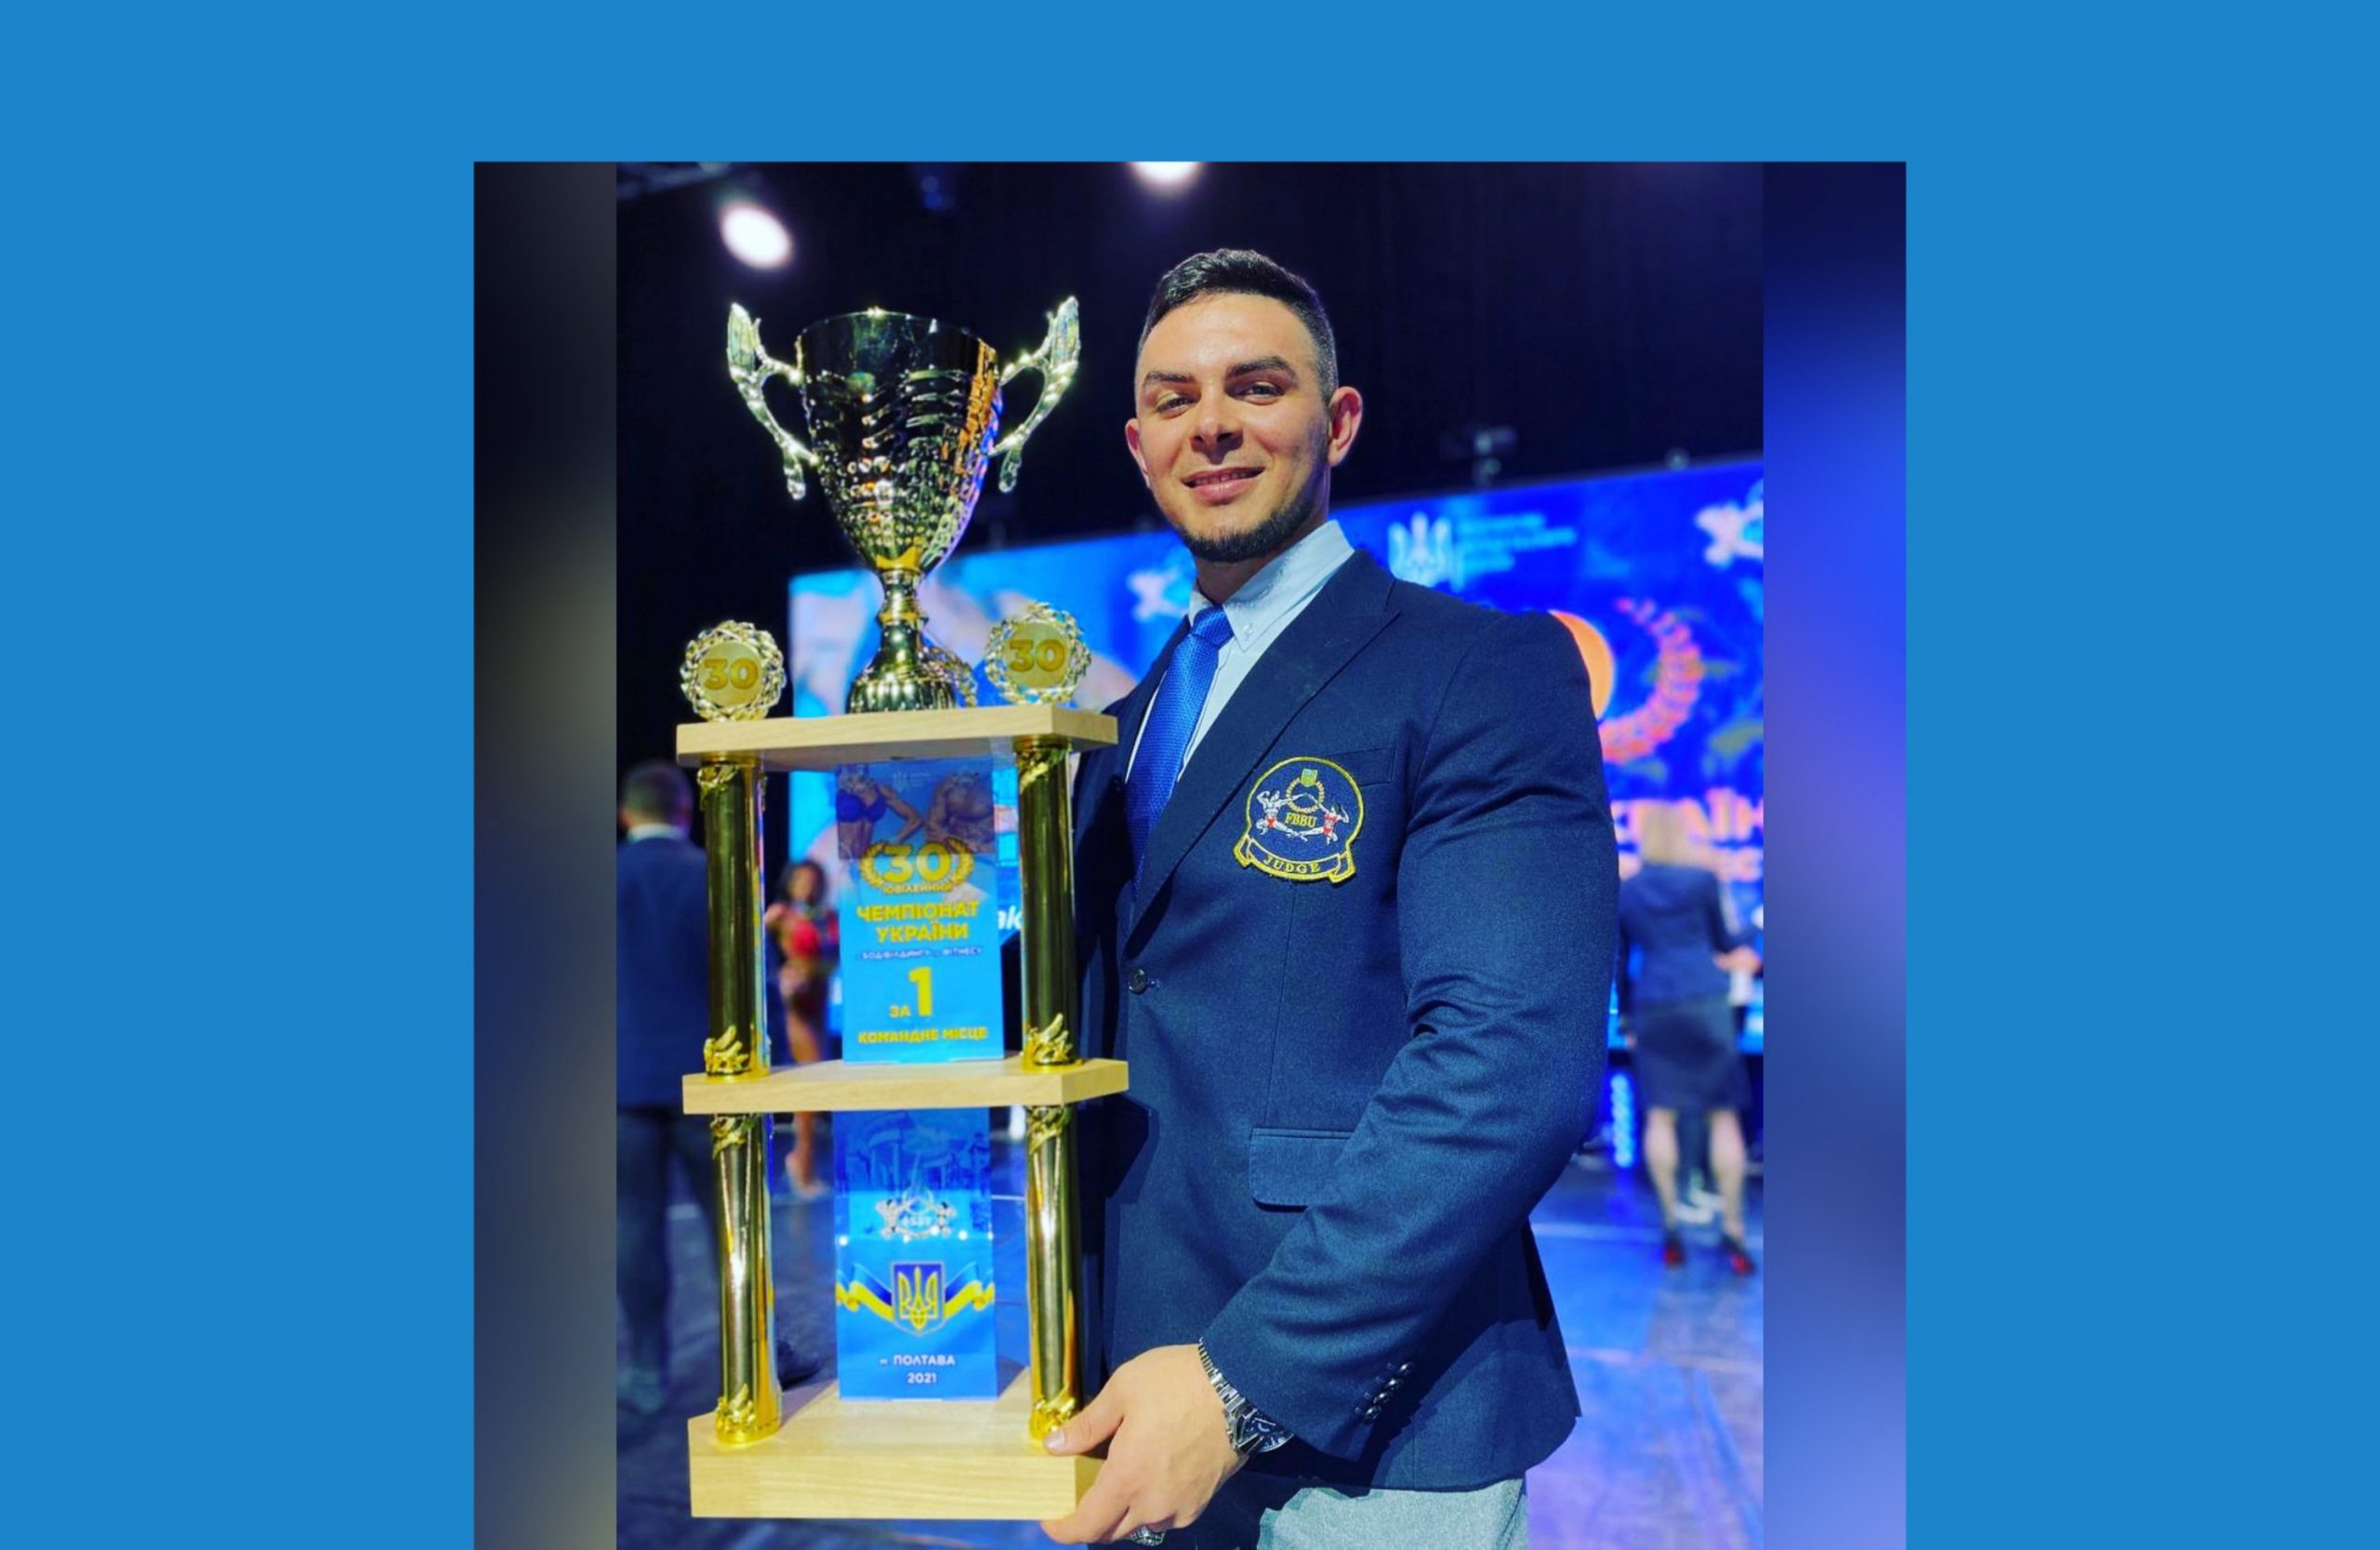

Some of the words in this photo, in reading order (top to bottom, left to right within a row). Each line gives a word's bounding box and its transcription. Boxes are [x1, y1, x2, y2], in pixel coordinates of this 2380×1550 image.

[1008, 638, 1066, 673] 30
[704, 657, 760, 691] 30
[1285, 812, 1317, 828] FBBU
[883, 842, 952, 884] 30
[1263, 854, 1320, 874] JUDGE
[856, 900, 980, 922] ЧЕМПІОНАТ
[876, 921, 969, 943] УКРАЇНИ
[889, 1004, 911, 1018] ЗА
[908, 966, 932, 1016] 1
[858, 1029, 938, 1043] КОМАНДНЕ
[893, 1354, 956, 1366] ПОЛТАВА
[907, 1371, 937, 1384] 2021
